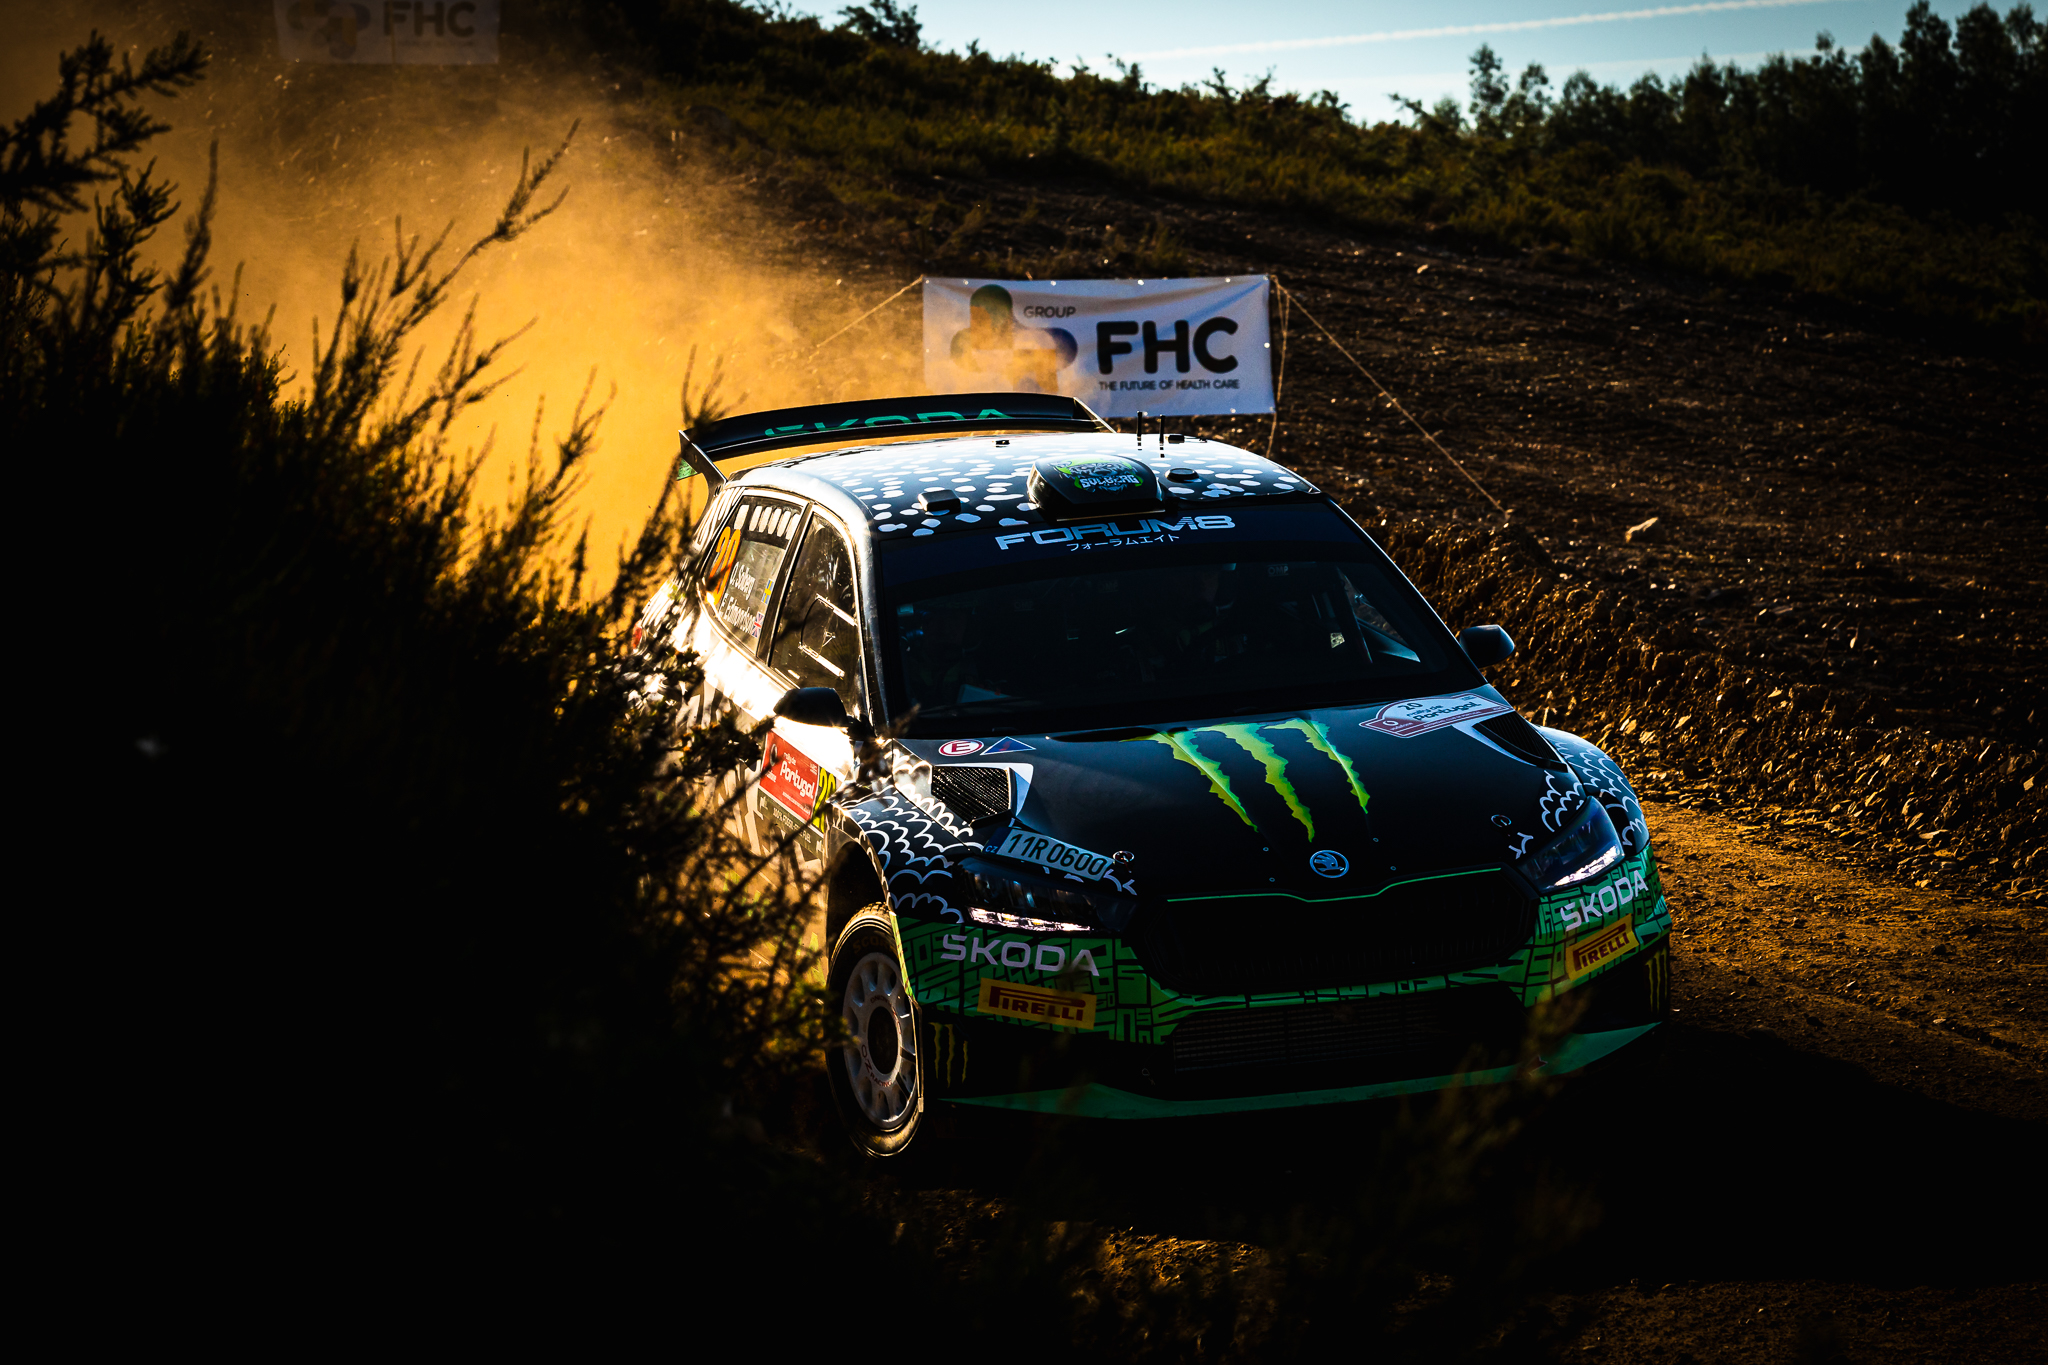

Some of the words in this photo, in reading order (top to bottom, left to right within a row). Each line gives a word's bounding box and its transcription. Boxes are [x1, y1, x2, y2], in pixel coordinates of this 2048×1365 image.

[384, 1, 477, 38] FHC
[1023, 305, 1076, 318] GROUP
[1096, 316, 1238, 375] FHC
[1099, 380, 1117, 391] THE
[1120, 380, 1156, 391] FUTURE
[1158, 379, 1174, 390] OF
[1176, 379, 1210, 390] HEALTH
[1213, 379, 1240, 390] CARE
[994, 515, 1236, 550] FORUM8
[1066, 533, 1180, 552] フォーラムエイト
[1413, 701, 1481, 720] Portugal
[780, 760, 815, 799] Portugal
[985, 845, 999, 854] CZ
[1573, 923, 1630, 972] PIRELLI
[989, 986, 1086, 1021] PIRELLI
